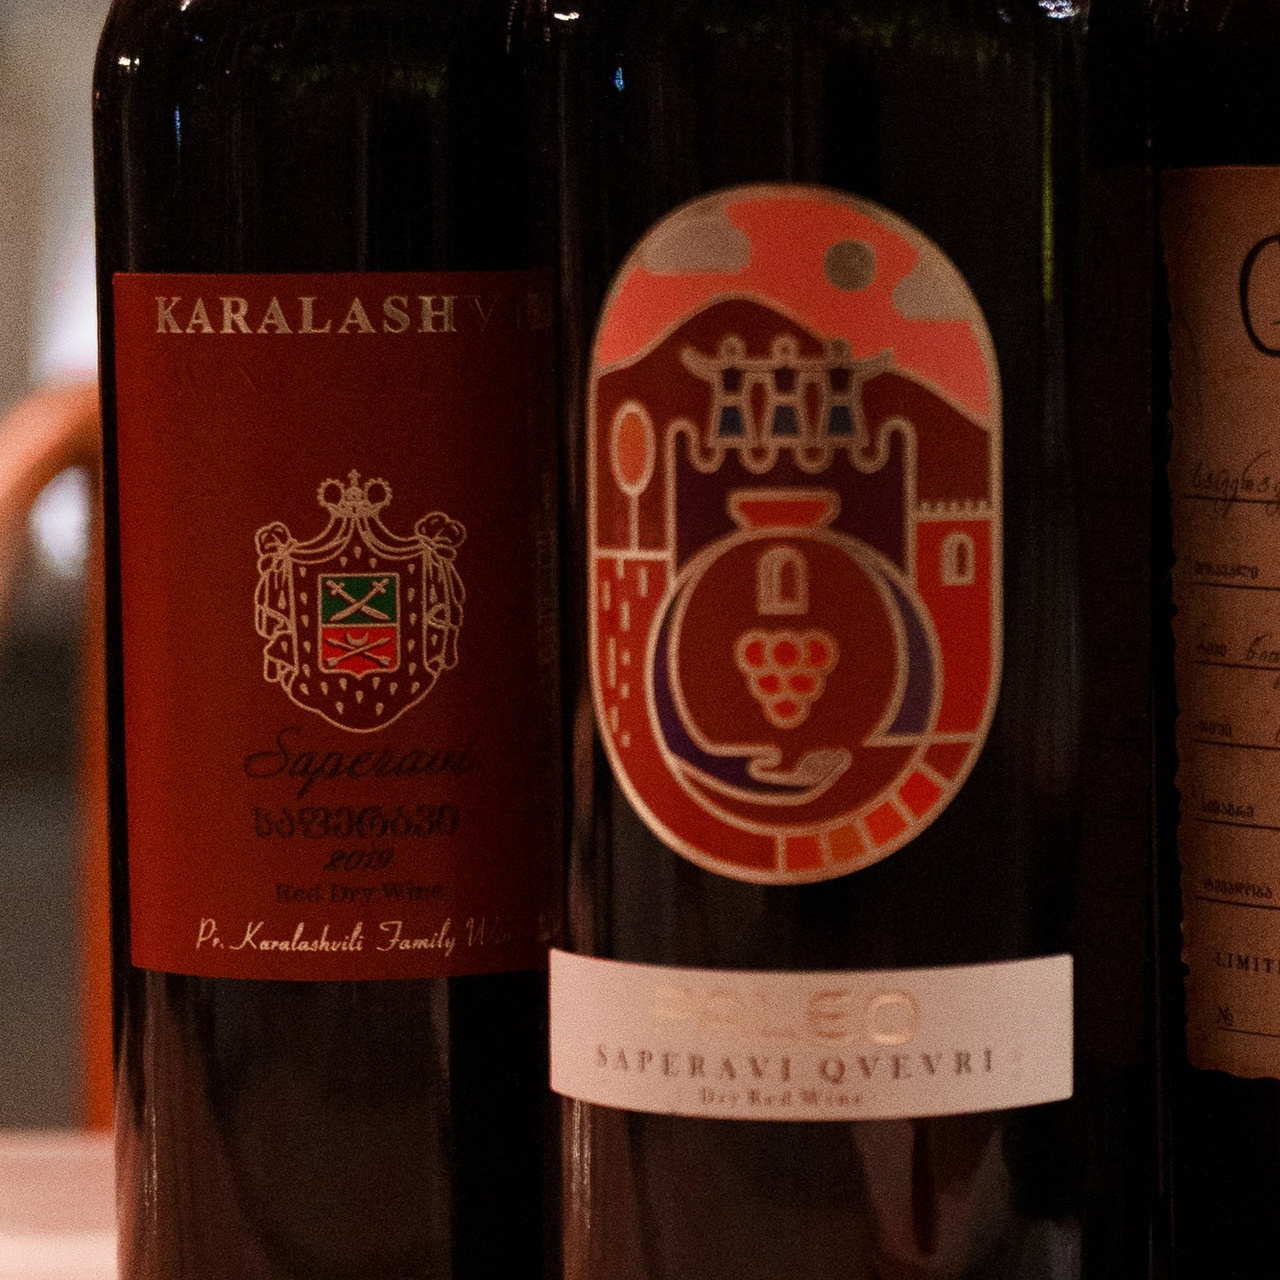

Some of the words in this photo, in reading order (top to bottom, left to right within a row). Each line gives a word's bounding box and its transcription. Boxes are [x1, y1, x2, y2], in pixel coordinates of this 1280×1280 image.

[276, 882, 322, 903] Red
[594, 1042, 793, 1082] SAPERAVI
[818, 1047, 996, 1086] QVEVRI
